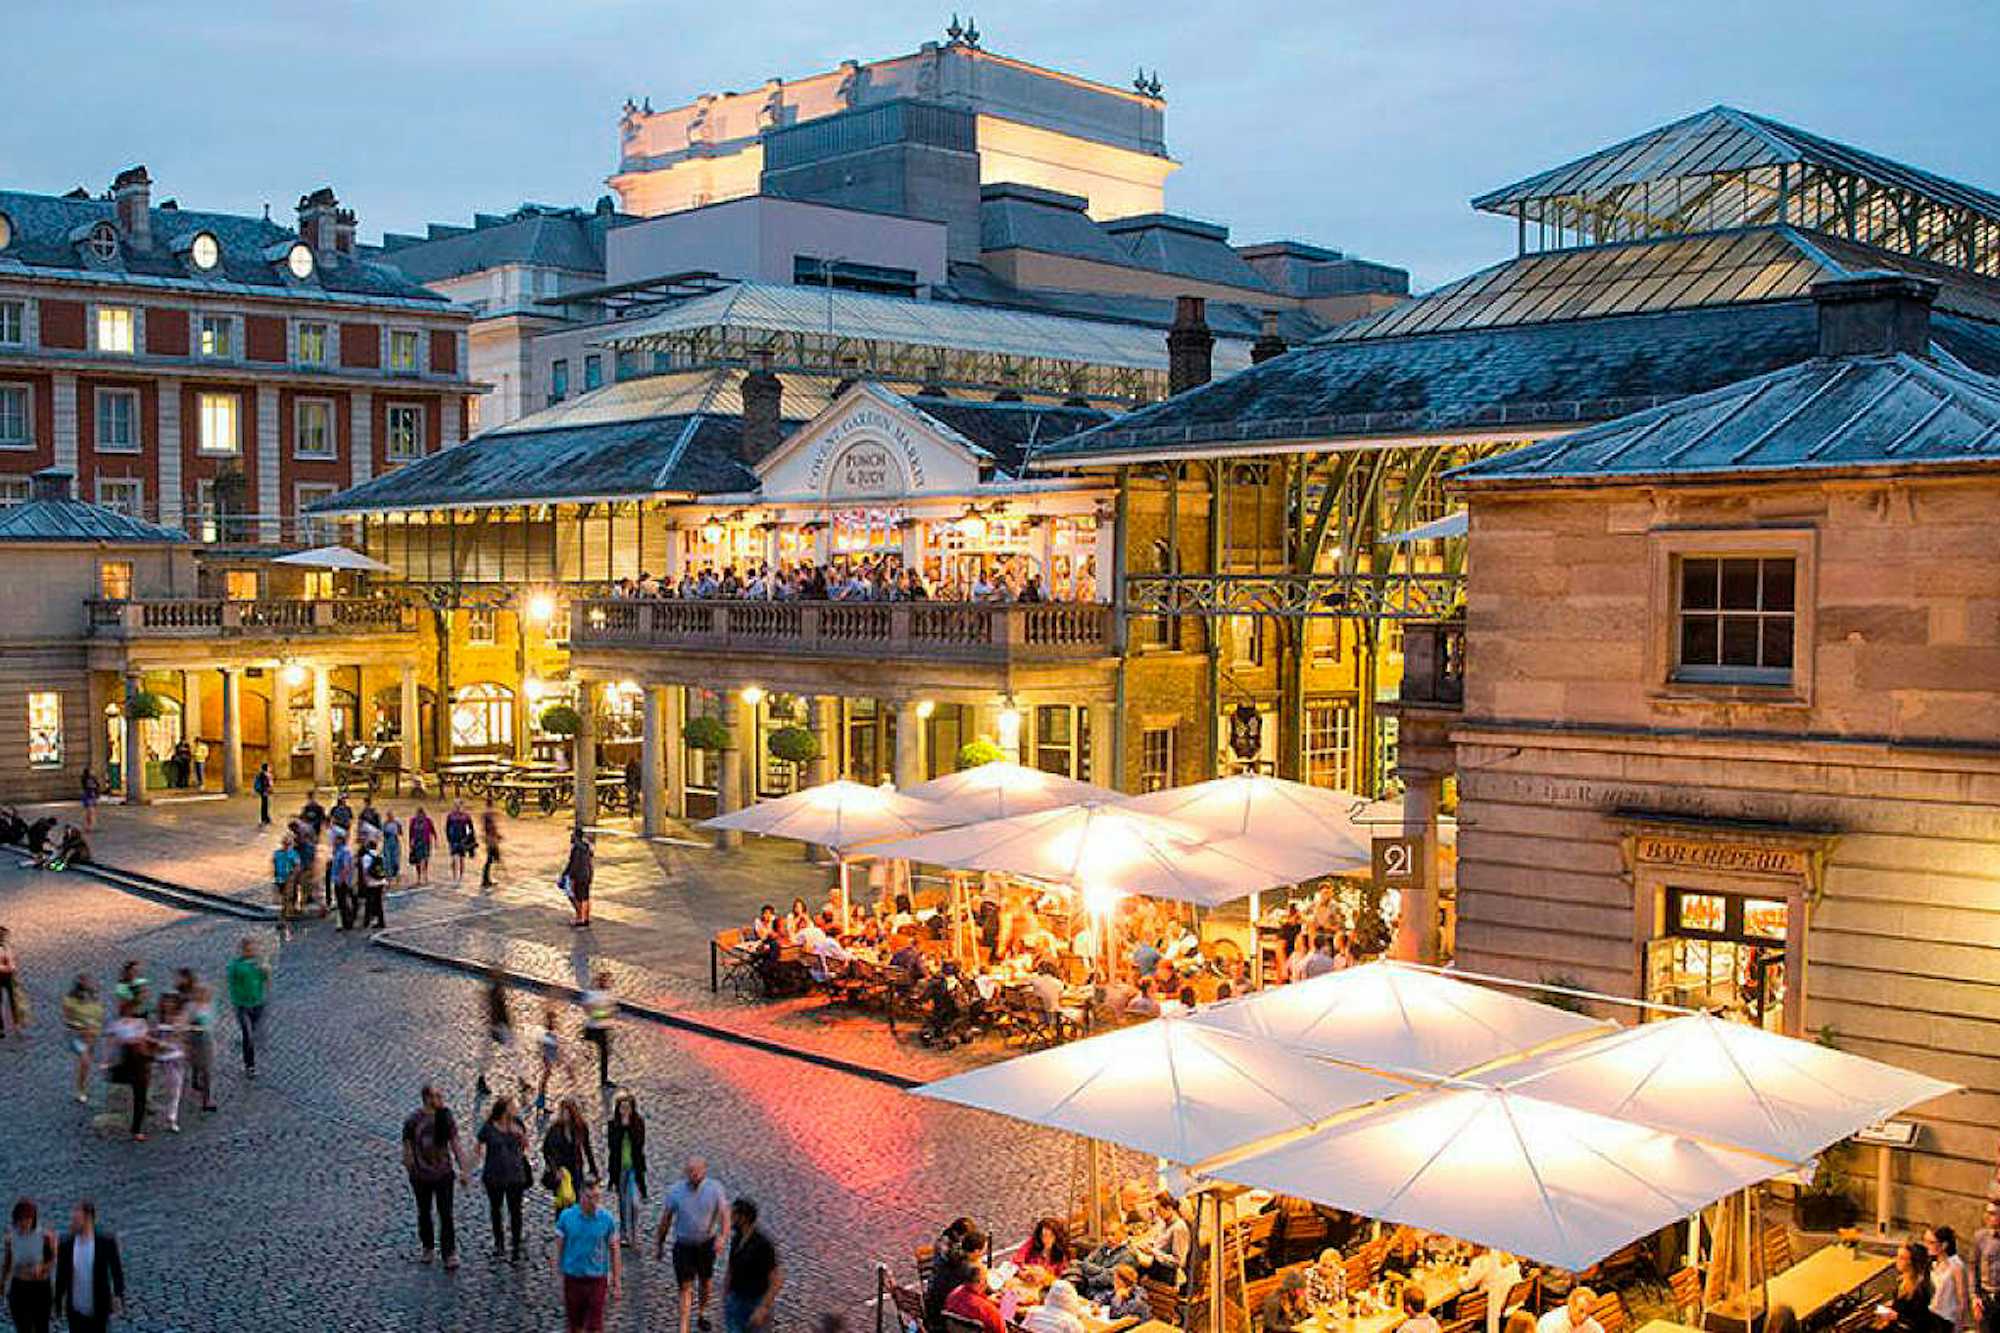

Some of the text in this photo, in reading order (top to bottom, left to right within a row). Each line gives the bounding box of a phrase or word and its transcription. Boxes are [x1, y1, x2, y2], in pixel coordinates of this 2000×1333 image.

[843, 410, 892, 433] GARDEN
[895, 425, 924, 488] MARKET
[846, 454, 886, 468] PUNCH
[846, 470, 886, 484] & JUDY
[1383, 844, 1412, 876] 21
